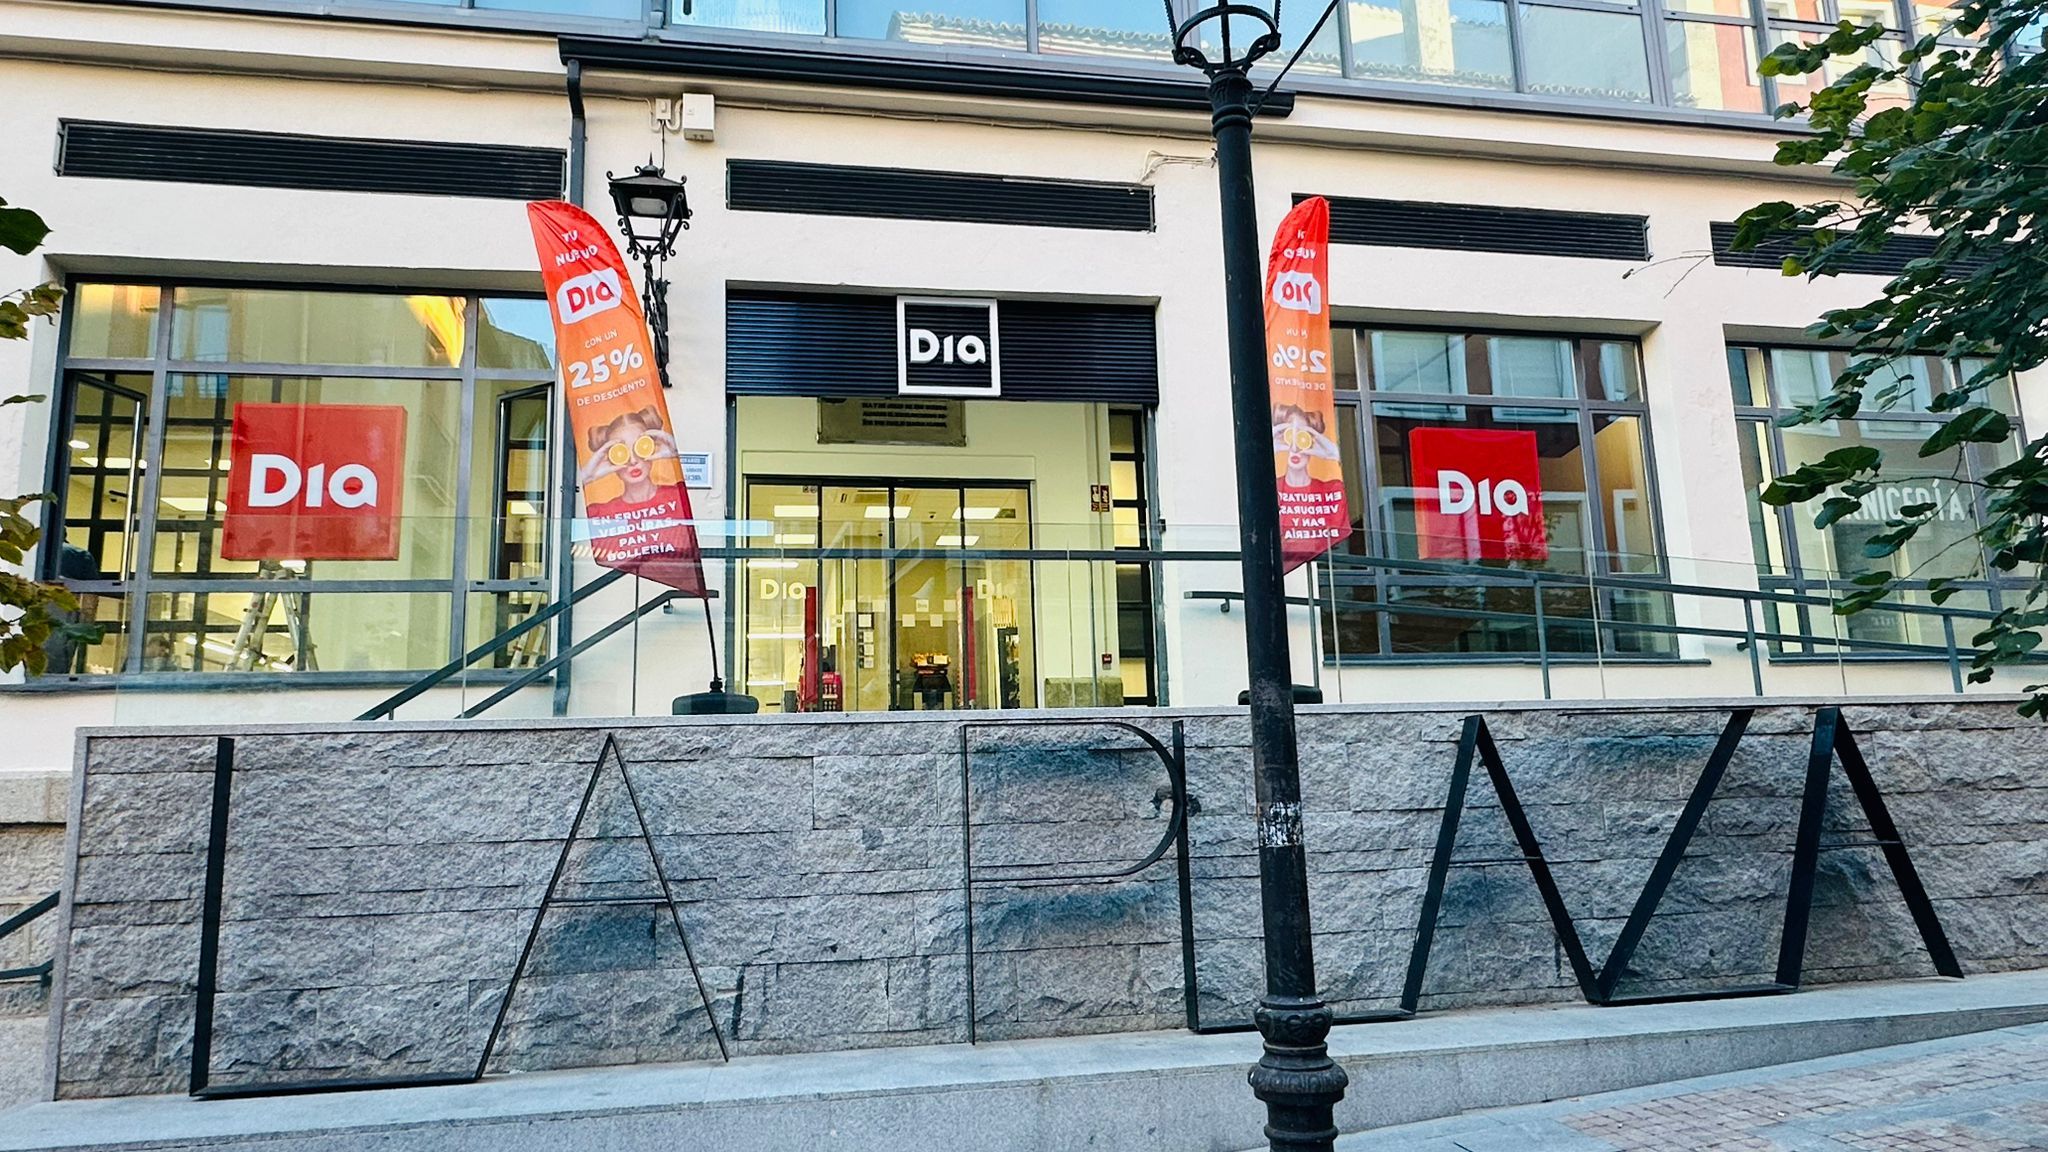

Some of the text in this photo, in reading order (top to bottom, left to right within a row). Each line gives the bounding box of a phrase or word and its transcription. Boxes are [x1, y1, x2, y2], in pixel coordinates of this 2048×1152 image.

[562, 230, 578, 242] TU
[555, 245, 598, 266] NUEVO
[585, 329, 618, 349] CON UN
[910, 329, 986, 364] Dia
[568, 343, 643, 389] 25%
[577, 379, 646, 406] DE DESCUENTO
[248, 454, 378, 508] Dia
[1437, 470, 1529, 516] Dia
[592, 501, 677, 525] EN FRUTAS Y
[607, 543, 675, 561] BOLLERÍA
[618, 533, 660, 547] PAN Y
